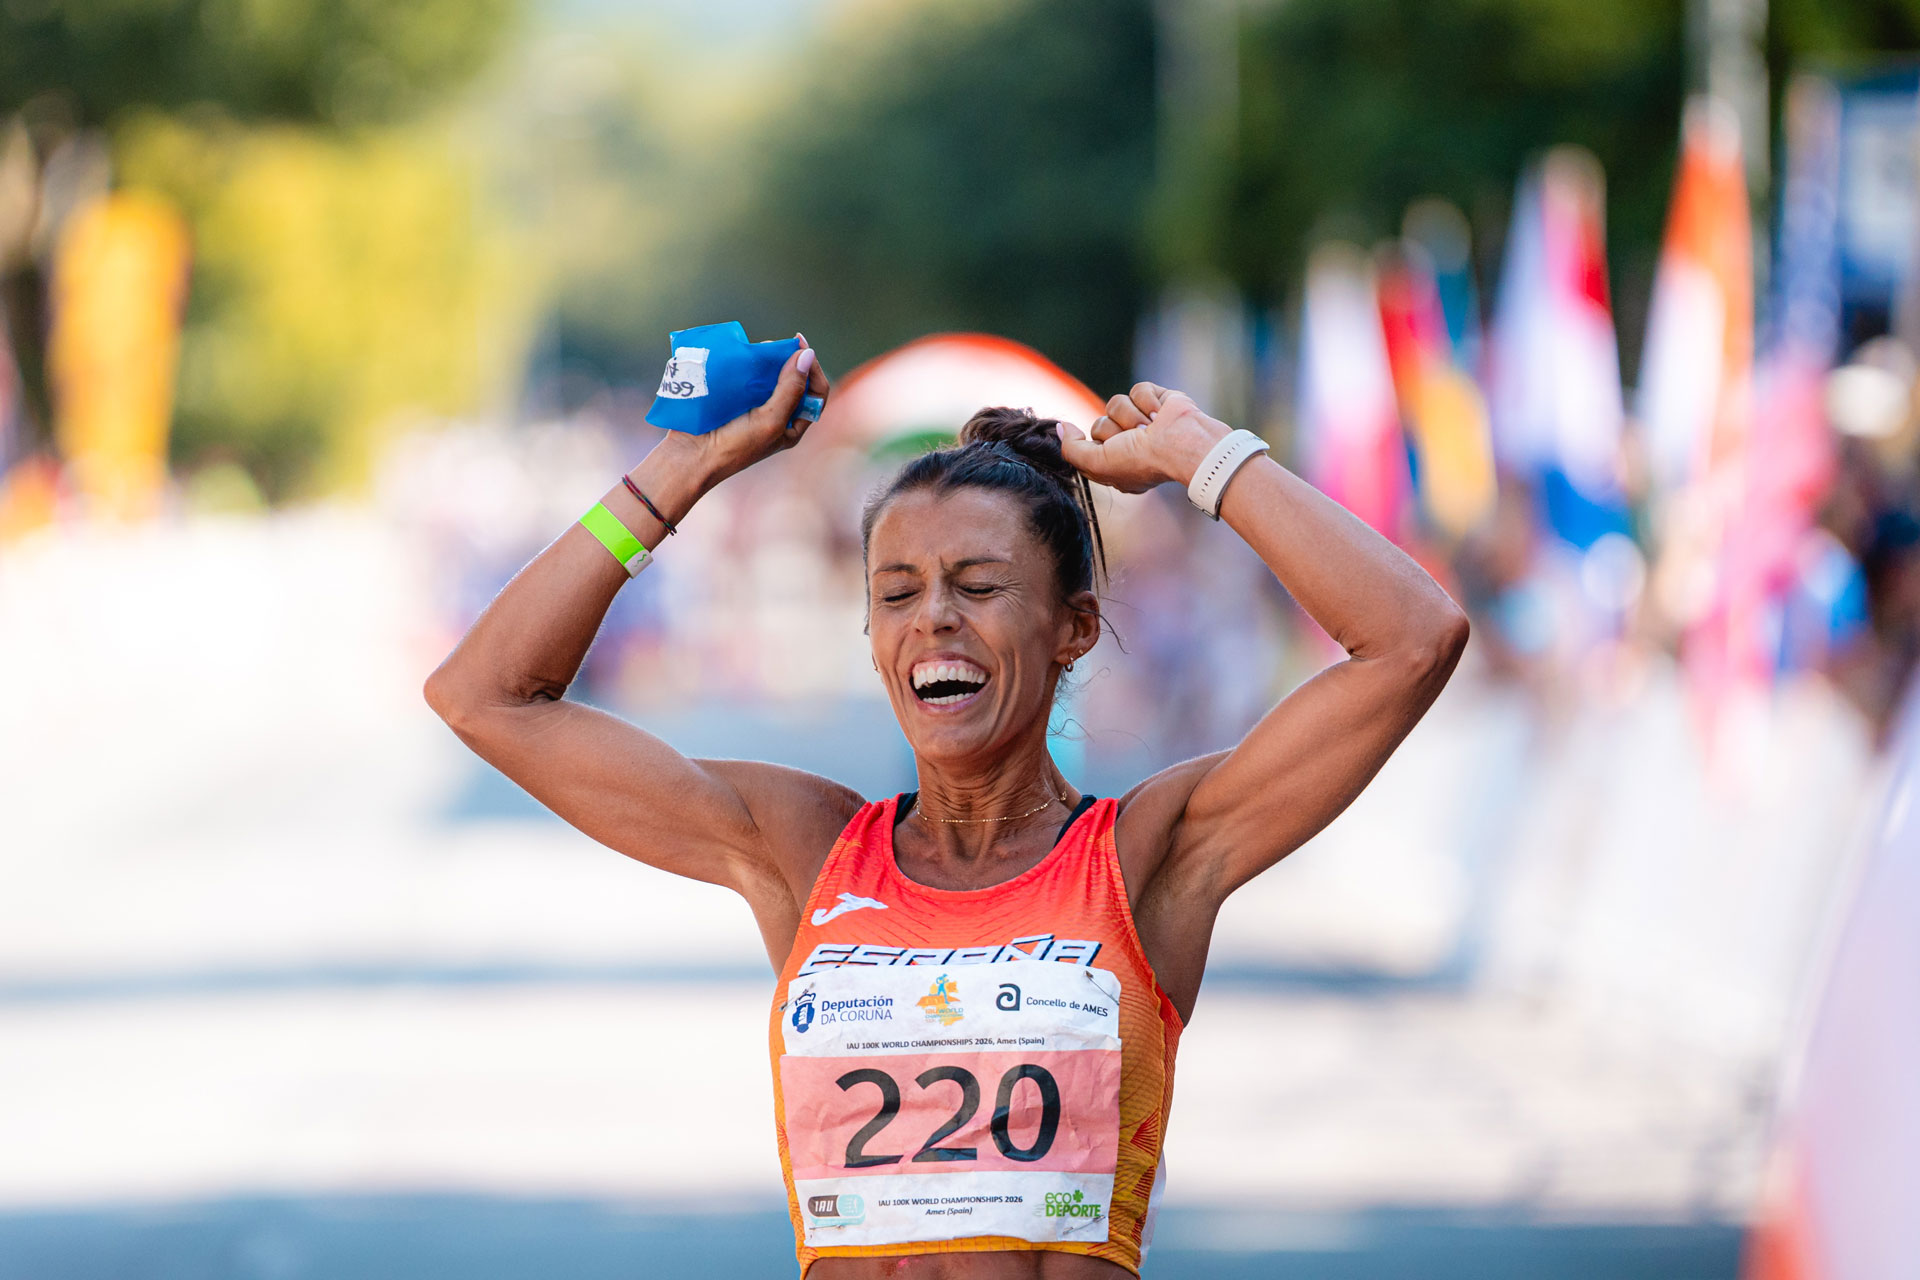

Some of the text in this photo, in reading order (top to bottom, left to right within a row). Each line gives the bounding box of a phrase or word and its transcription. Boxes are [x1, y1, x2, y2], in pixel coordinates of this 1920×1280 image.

[821, 995, 893, 1012] Deputación
[1026, 997, 1108, 1017] Concello de AMES
[821, 1006, 893, 1025] DA CORUÑA
[911, 1038, 973, 1047] CHAMPIONSHIPS
[975, 1038, 995, 1046] 2026,
[1018, 1037, 1045, 1046] (Spain)
[835, 1063, 1061, 1168] 220
[940, 1196, 1003, 1204] CHAMPIONSHIPS
[1044, 1192, 1072, 1204] eco
[815, 1200, 834, 1212] IAU
[946, 1207, 973, 1216] (Spain)
[1045, 1204, 1101, 1218] DEPORTE
